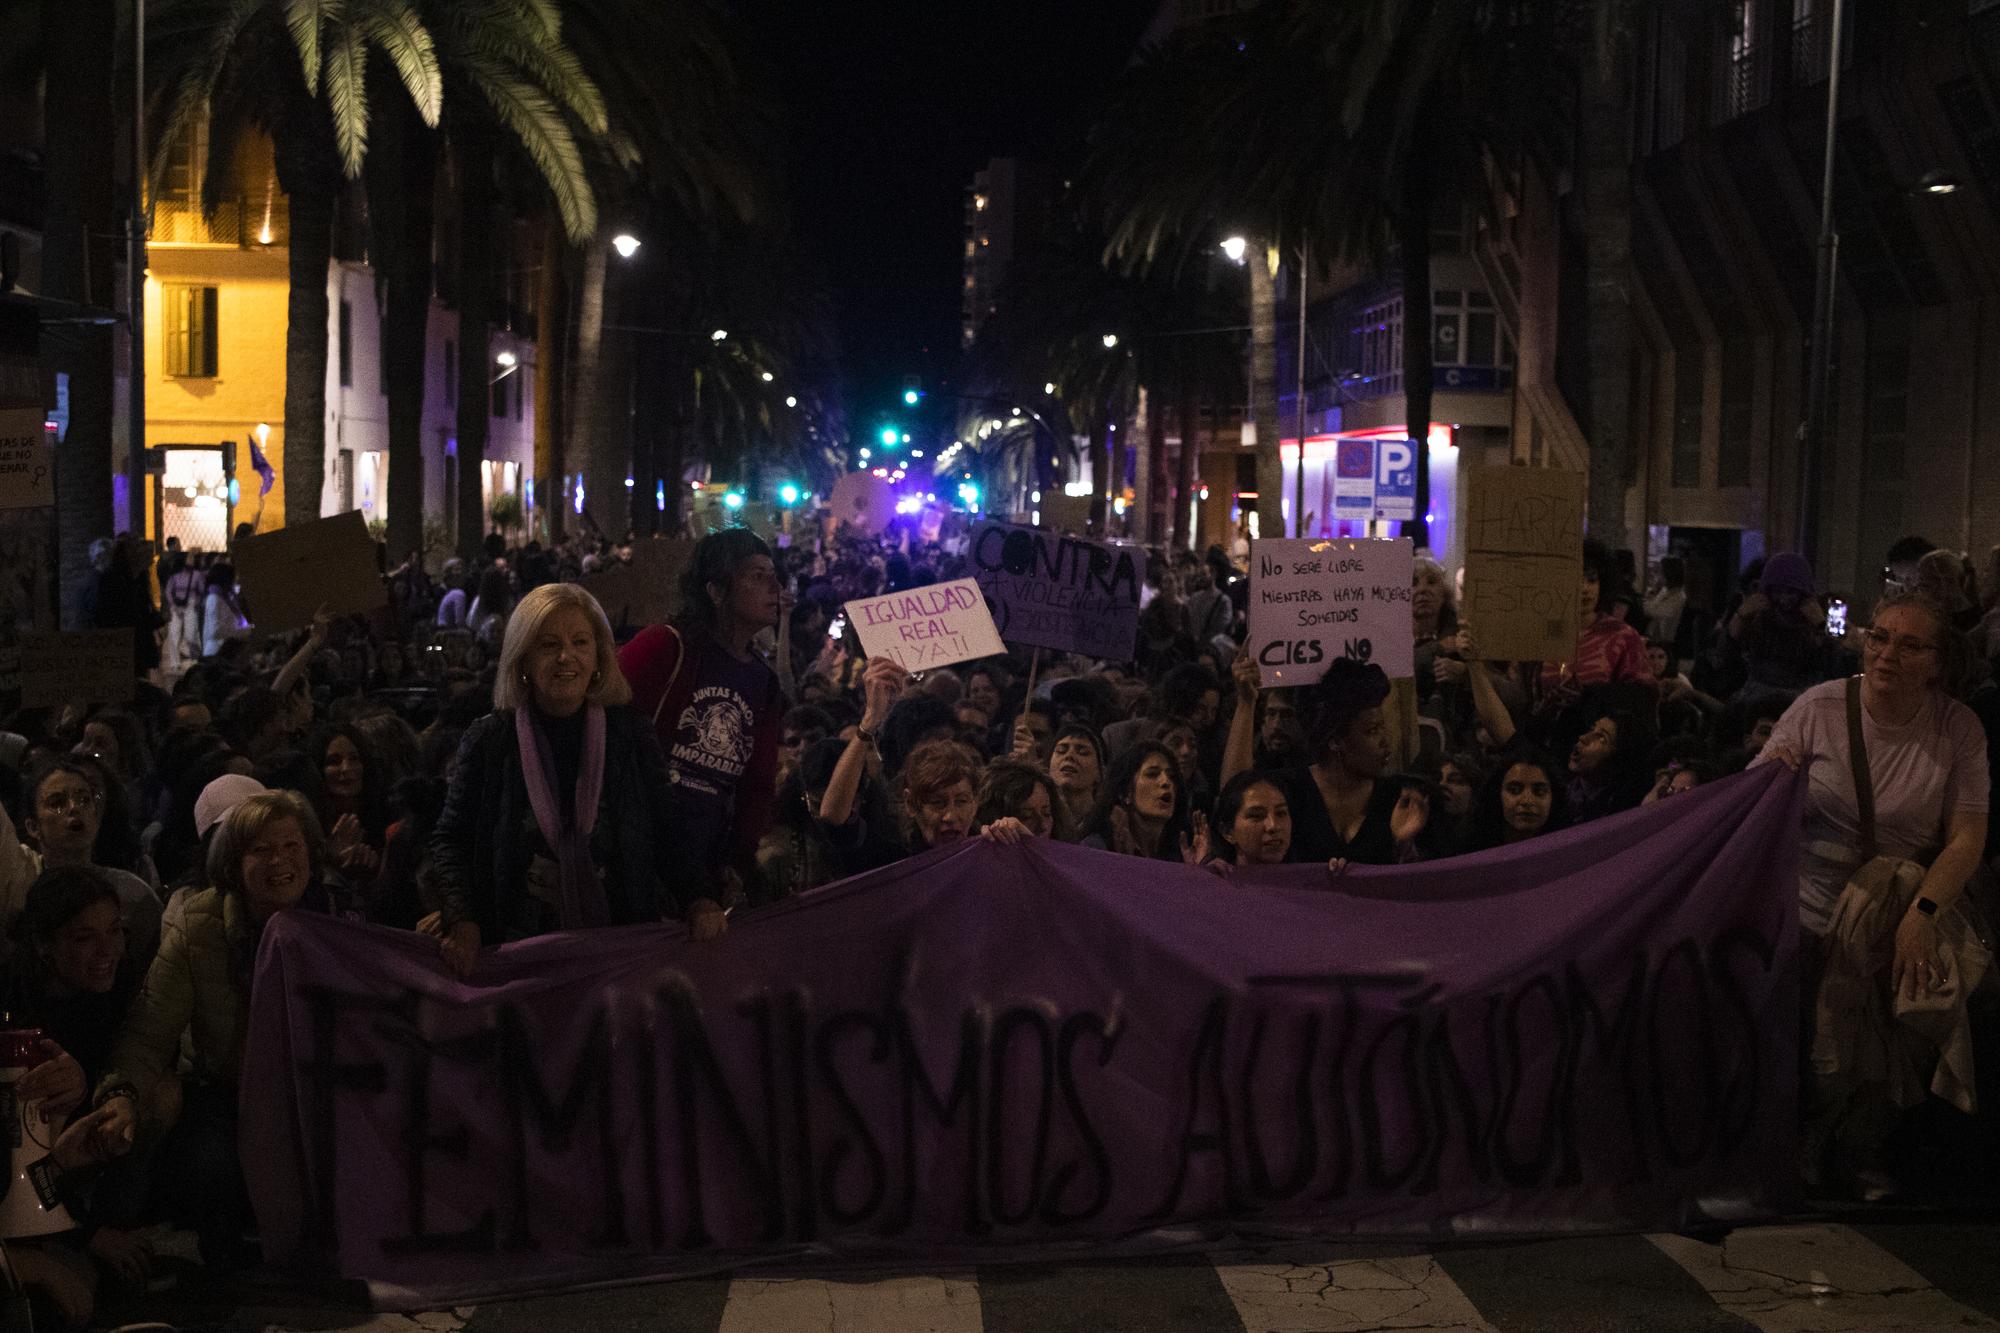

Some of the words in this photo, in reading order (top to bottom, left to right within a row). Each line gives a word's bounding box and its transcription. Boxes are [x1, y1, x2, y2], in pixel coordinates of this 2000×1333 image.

[16, 450, 32, 460] NO
[21, 436, 35, 447] DE
[1379, 442, 1412, 486] P
[1474, 488, 1577, 551] HARTA
[975, 527, 1138, 606] CONTRA
[1328, 558, 1365, 574] LIBRE
[860, 586, 977, 626] IGUALDAD
[1012, 578, 1136, 618] VIOLENCIA
[1333, 585, 1366, 602] HAYA
[1472, 577, 1574, 621] ESTOY
[899, 617, 959, 643] REAL
[1259, 638, 1324, 667] CIES
[1344, 636, 1373, 664] NO
[692, 686, 732, 704] JUNTAS
[670, 743, 746, 777] IMPARABLES
[292, 945, 1124, 1262] FEMINISMOS
